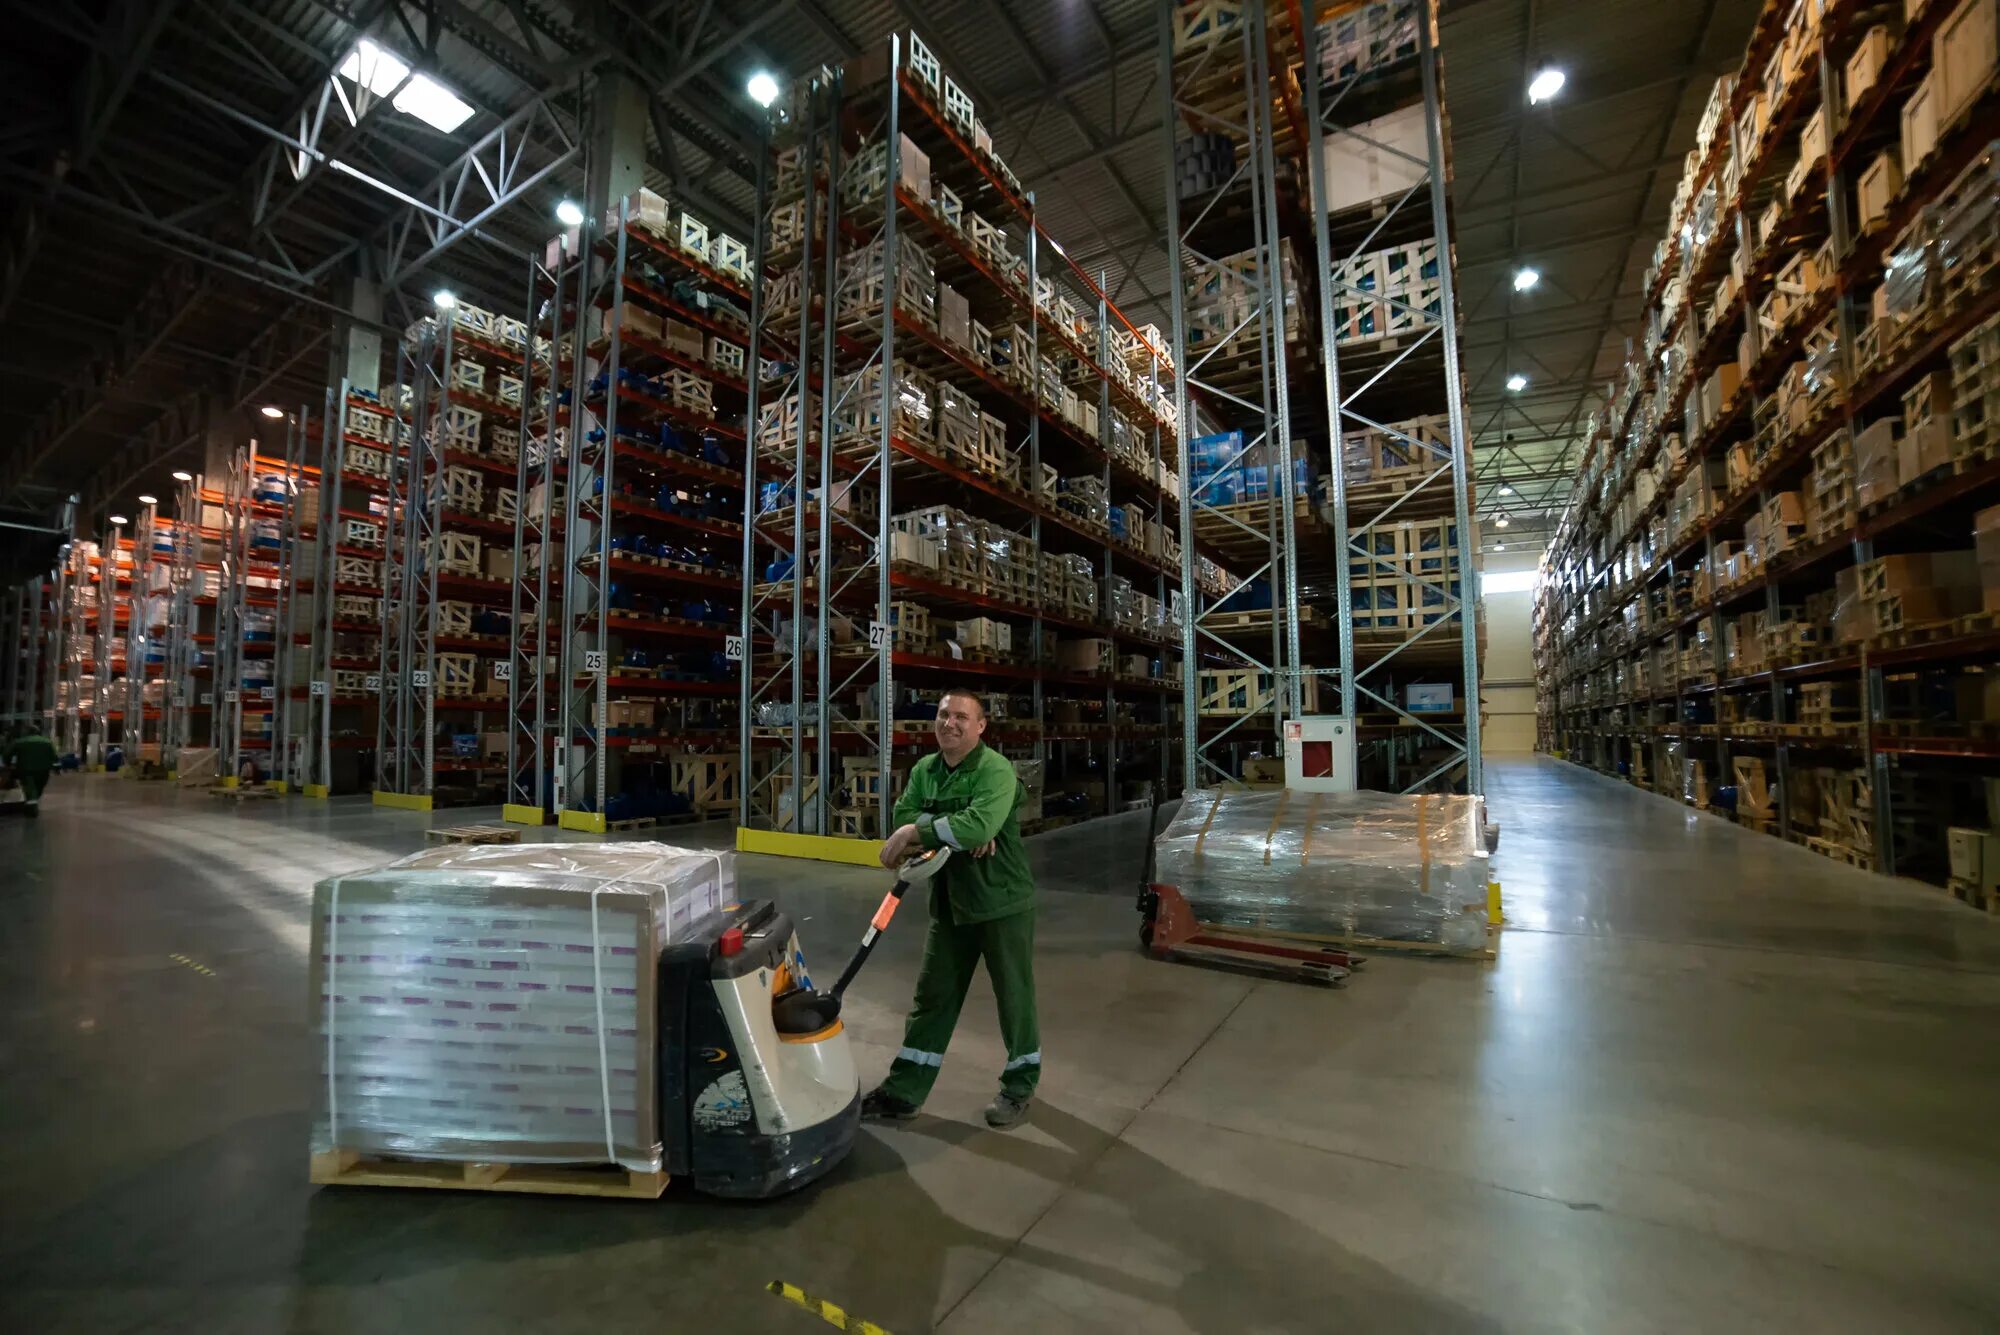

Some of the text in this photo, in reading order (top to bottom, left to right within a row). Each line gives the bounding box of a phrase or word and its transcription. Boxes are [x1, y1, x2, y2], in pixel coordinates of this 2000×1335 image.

[871, 626, 885, 645] 27
[727, 639, 742, 656] 26
[587, 654, 601, 668] 25
[496, 664, 510, 676] 24
[367, 678, 379, 688] 22
[415, 673, 428, 684] 23
[263, 688, 272, 697] 20
[312, 683, 323, 692] 21
